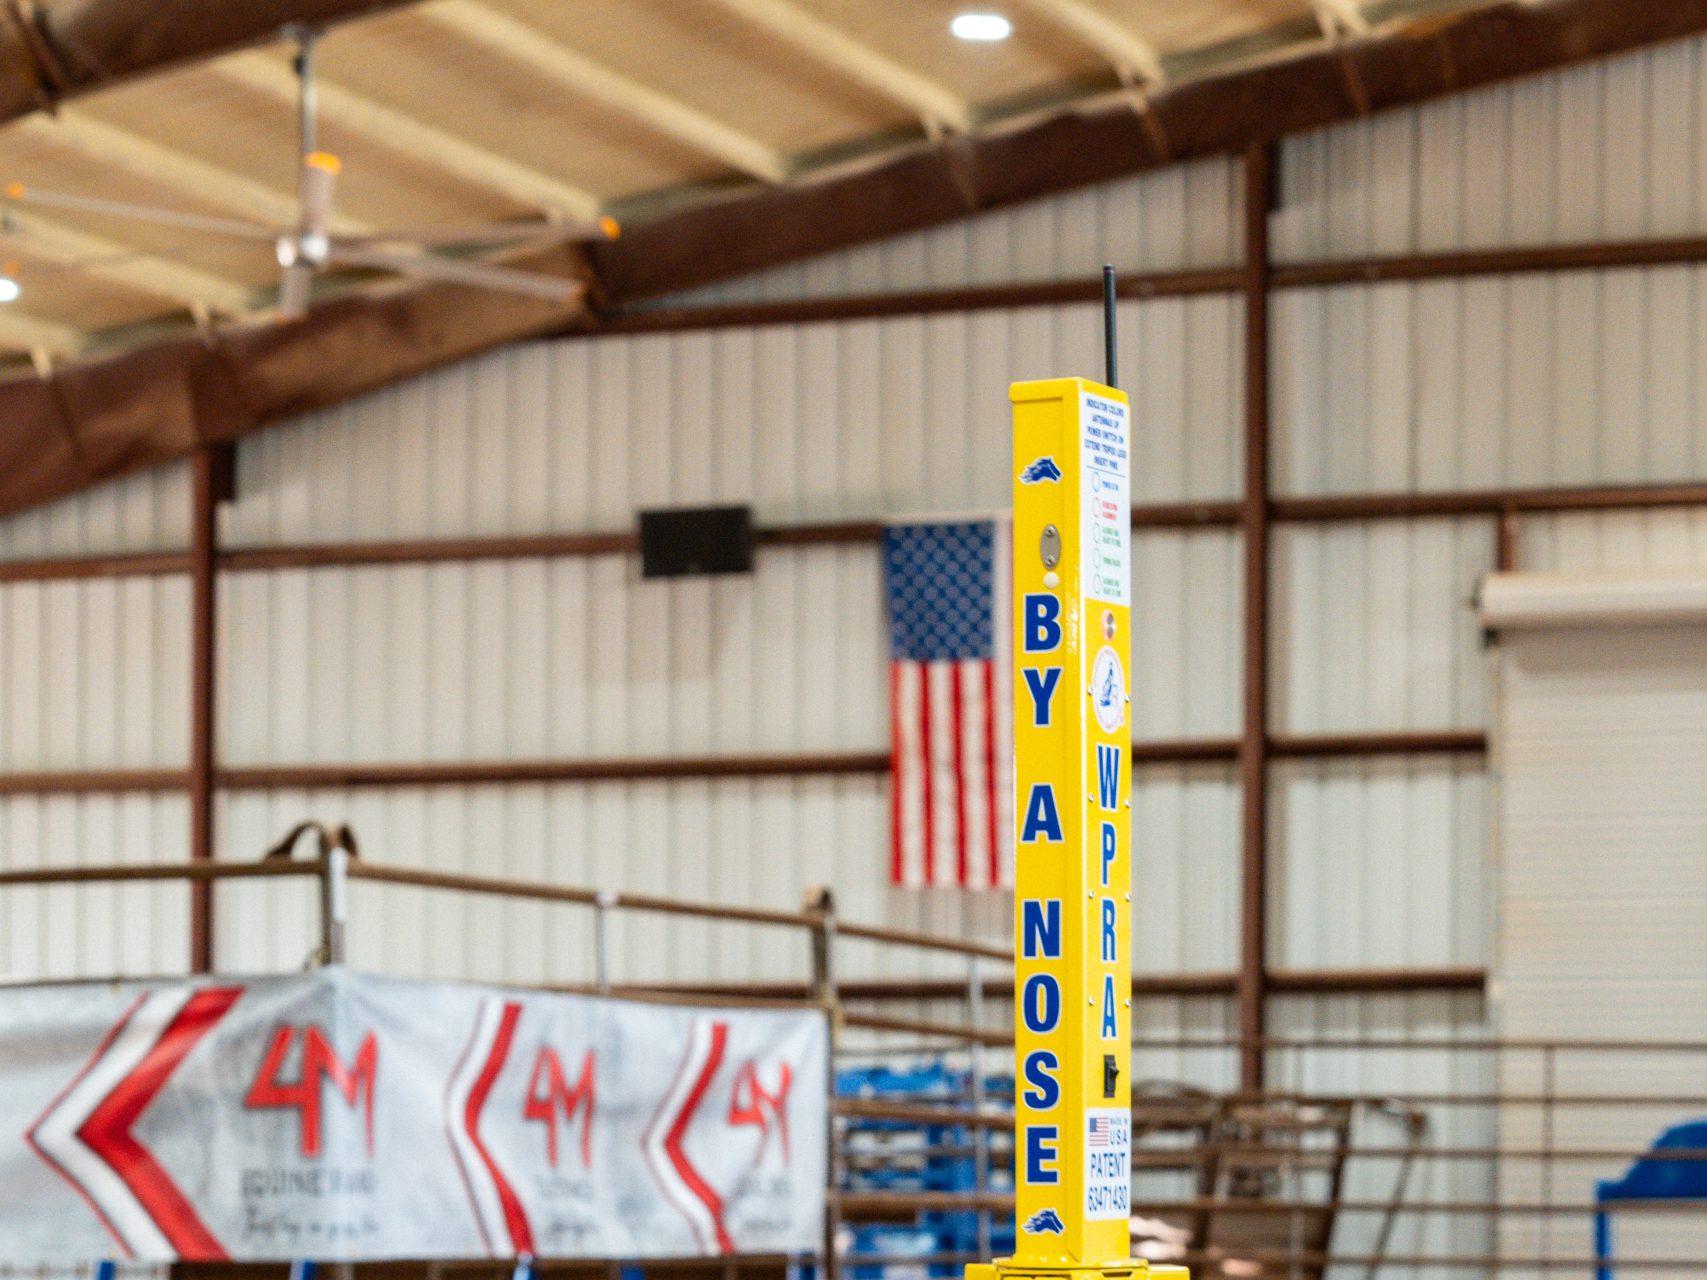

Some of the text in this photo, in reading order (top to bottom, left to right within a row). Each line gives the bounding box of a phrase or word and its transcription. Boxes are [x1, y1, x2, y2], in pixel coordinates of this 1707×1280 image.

[1021, 593, 1064, 1186] BY A NOSE
[1096, 743, 1121, 1040] WPRA
[244, 1024, 378, 1159] 4M
[522, 1045, 597, 1167] 4M
[1110, 1129, 1128, 1145] USA
[1090, 1152, 1126, 1178] PATENT
